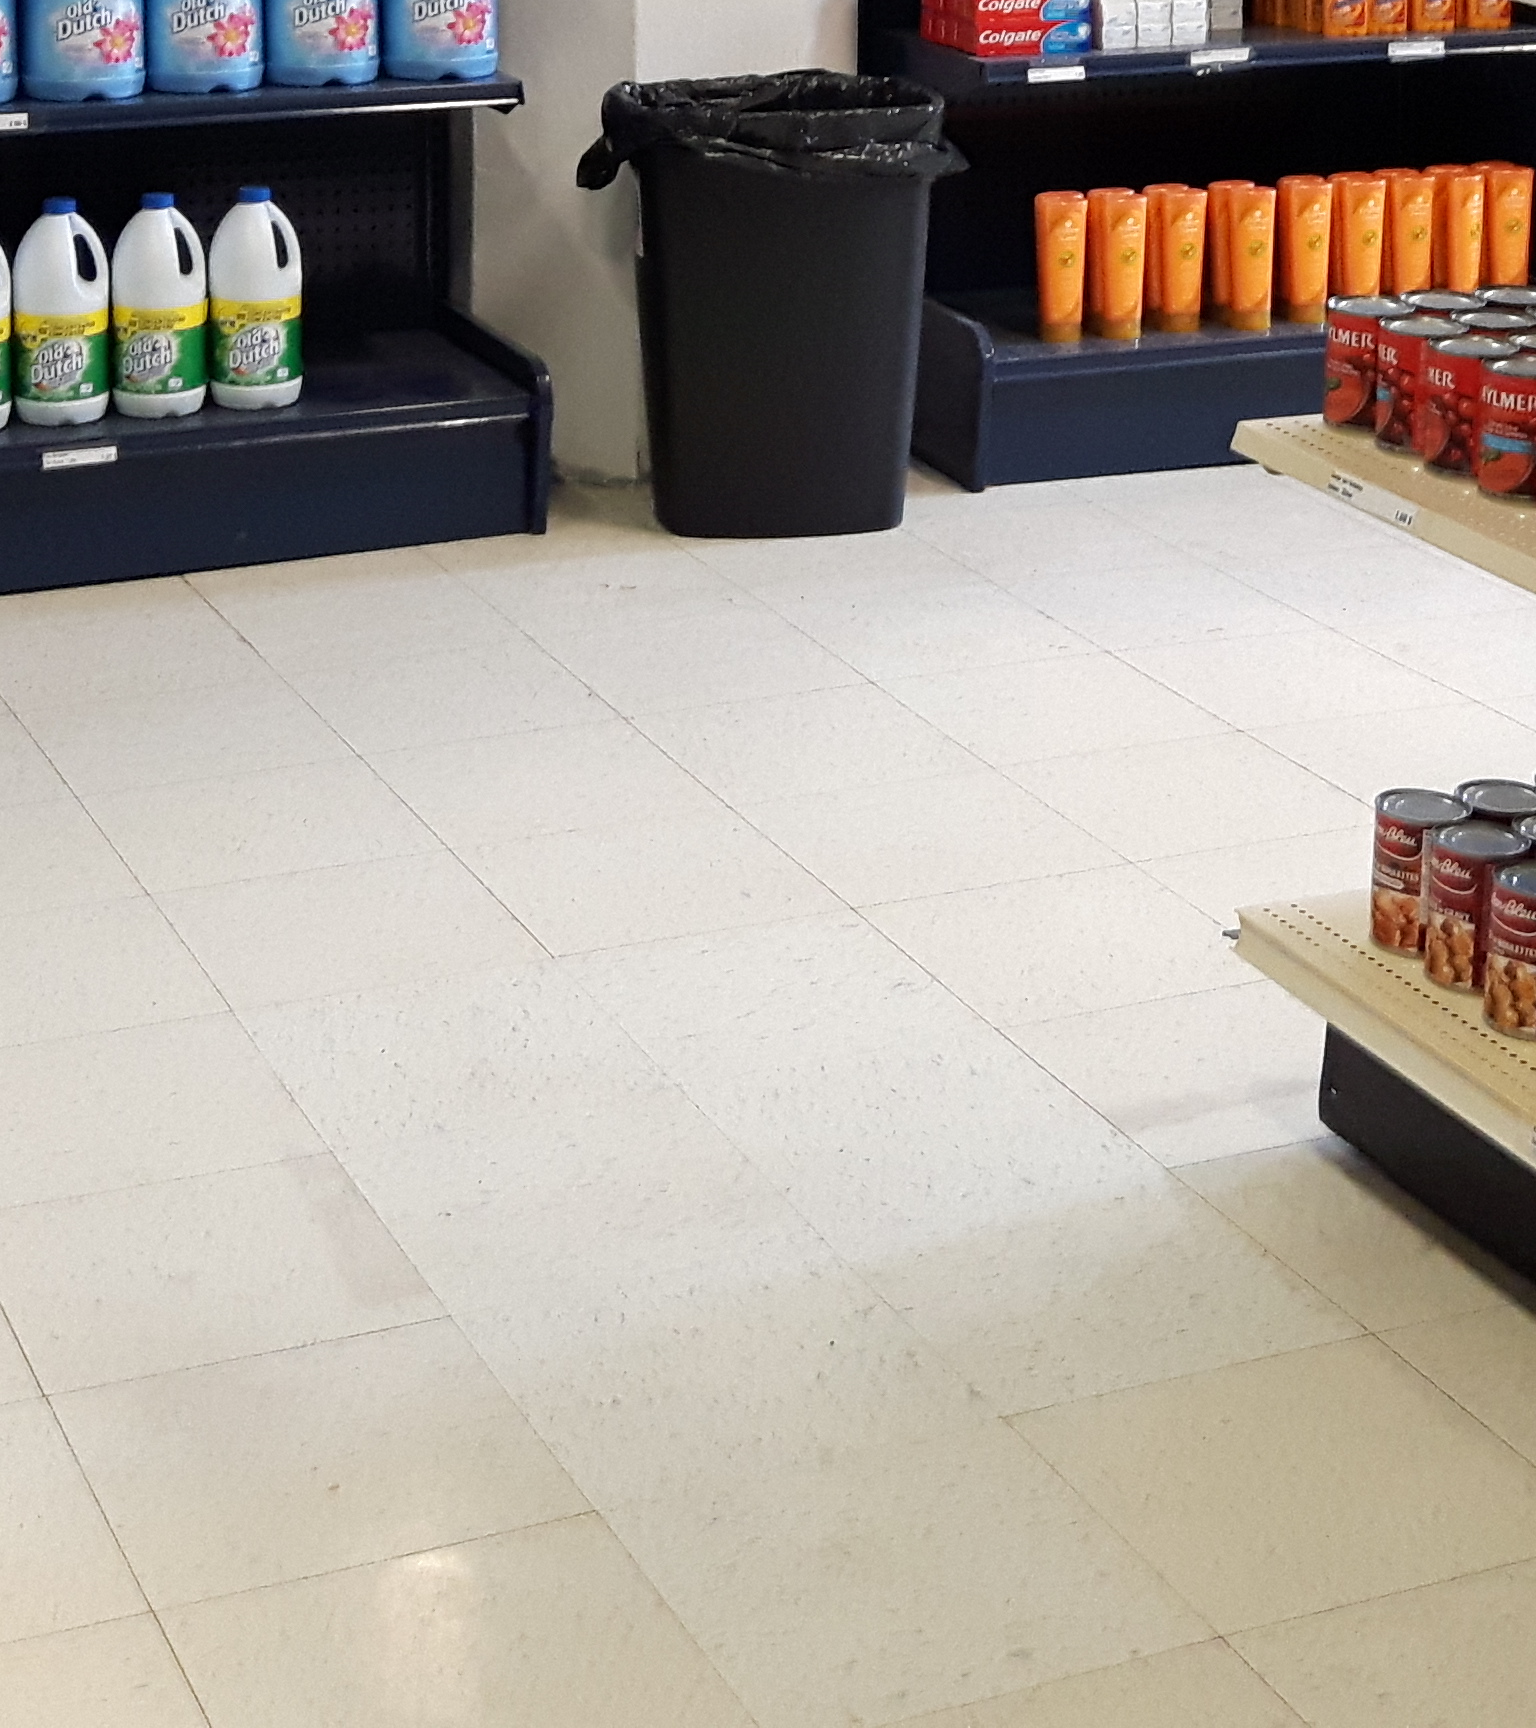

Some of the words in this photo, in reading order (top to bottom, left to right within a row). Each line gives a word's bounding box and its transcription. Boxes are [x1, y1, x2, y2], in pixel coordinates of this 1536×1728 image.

[55, 8, 113, 41] Dutch
[170, 1, 226, 35] Dutch
[979, 29, 1042, 46] Colgate
[37, 345, 66, 366] Old
[128, 338, 156, 360] Old
[228, 339, 280, 370] Dutch
[237, 332, 264, 352] Old
[30, 354, 84, 386] Dutch
[121, 346, 173, 374] Dutch
